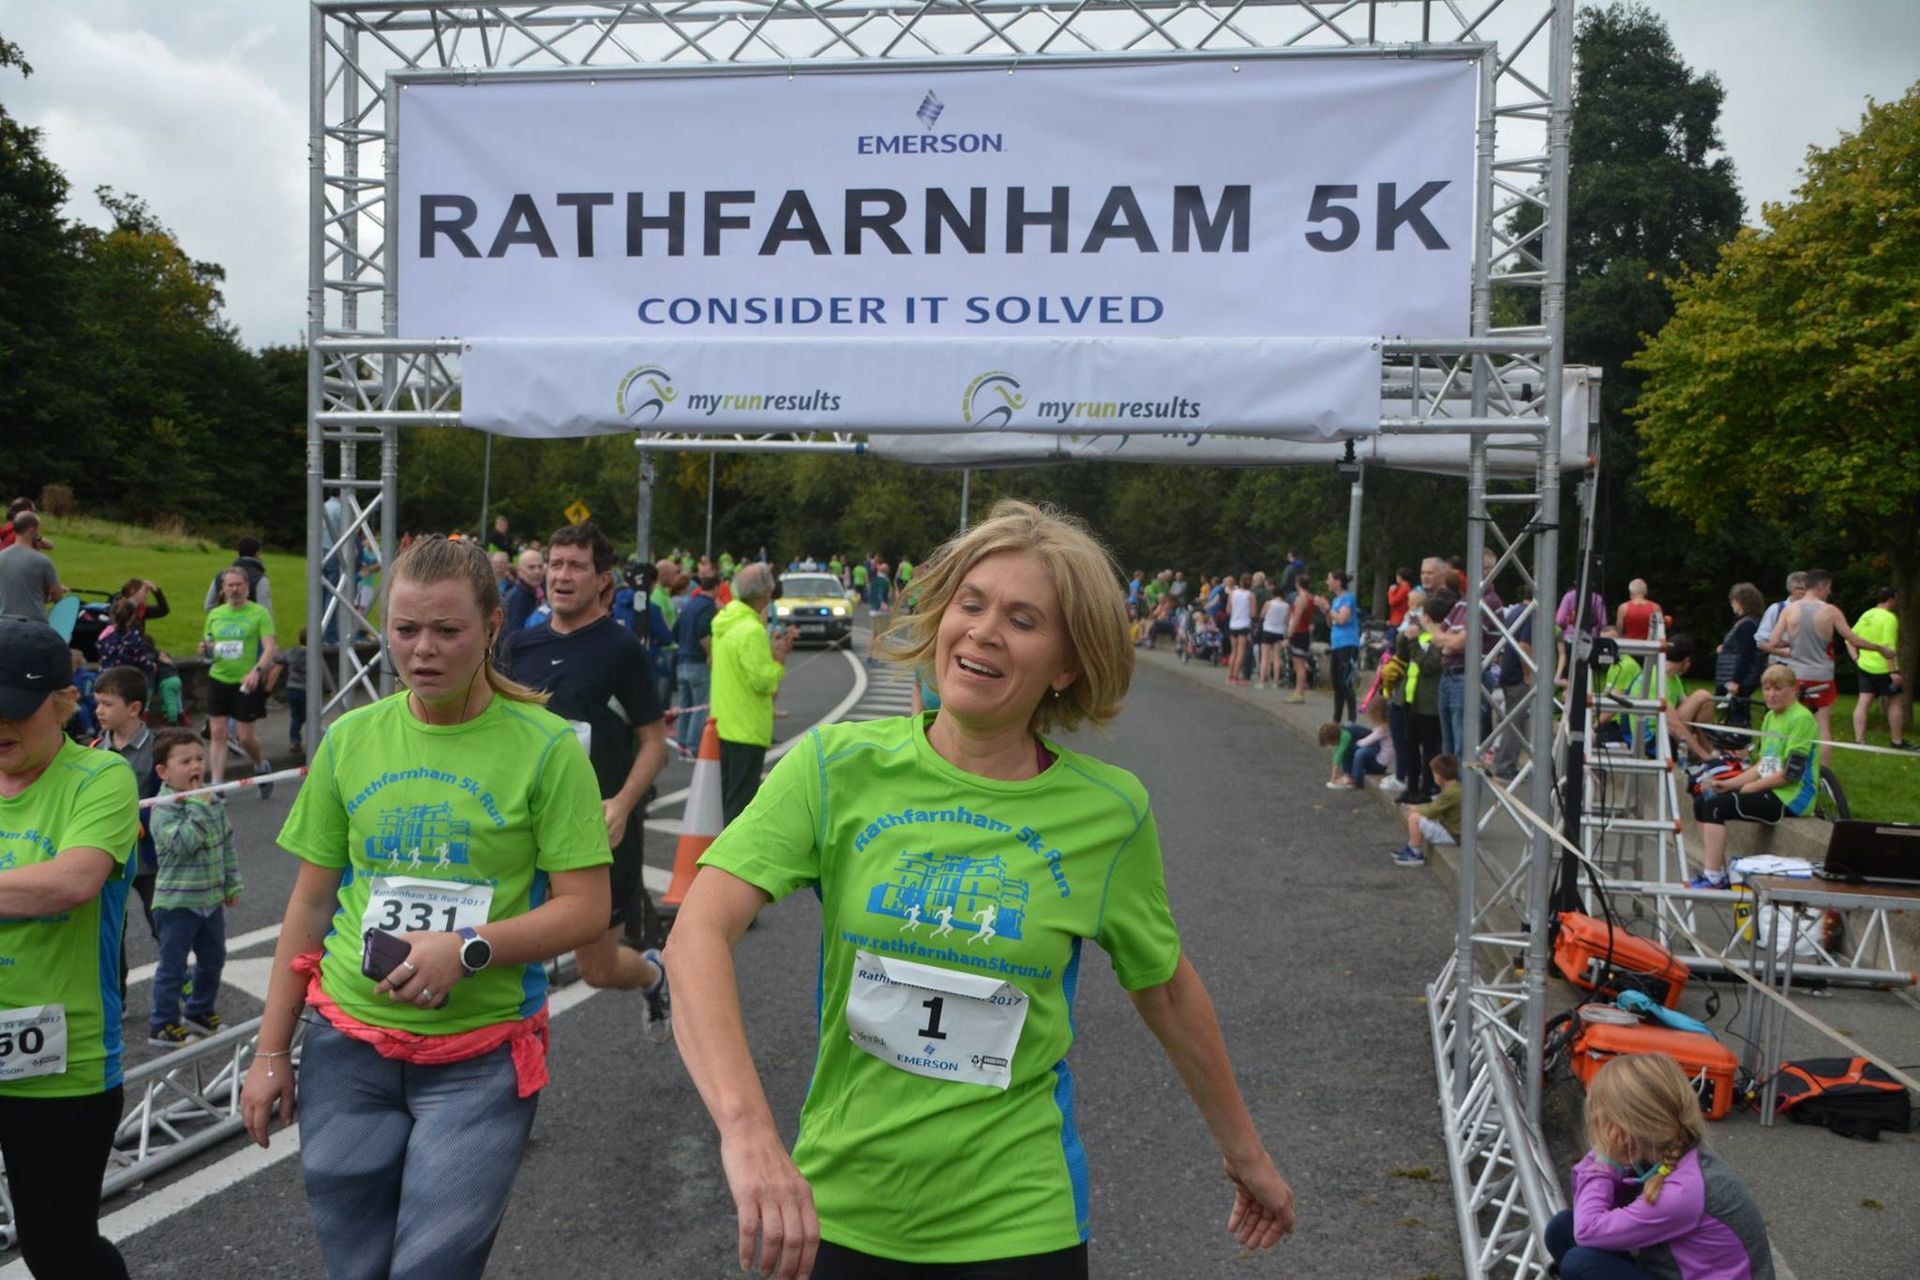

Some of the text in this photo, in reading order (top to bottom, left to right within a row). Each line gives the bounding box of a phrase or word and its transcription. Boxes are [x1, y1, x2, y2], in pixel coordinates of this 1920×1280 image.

[858, 133, 1003, 154] EMERSON
[419, 180, 1452, 258] RATHFARNHAM 5K
[638, 296, 1164, 324] CONSIDER IT SOLVED
[687, 389, 841, 416] myrunresults
[1038, 396, 1200, 421] myrunresults
[347, 768, 506, 828] Rathfarnham 5k Run
[854, 806, 1071, 899] Rathfarnham 5k Run
[378, 899, 458, 932] 331
[989, 994, 1022, 1007] 2017
[918, 996, 948, 1041] 1
[896, 1053, 959, 1072] EMERSON
